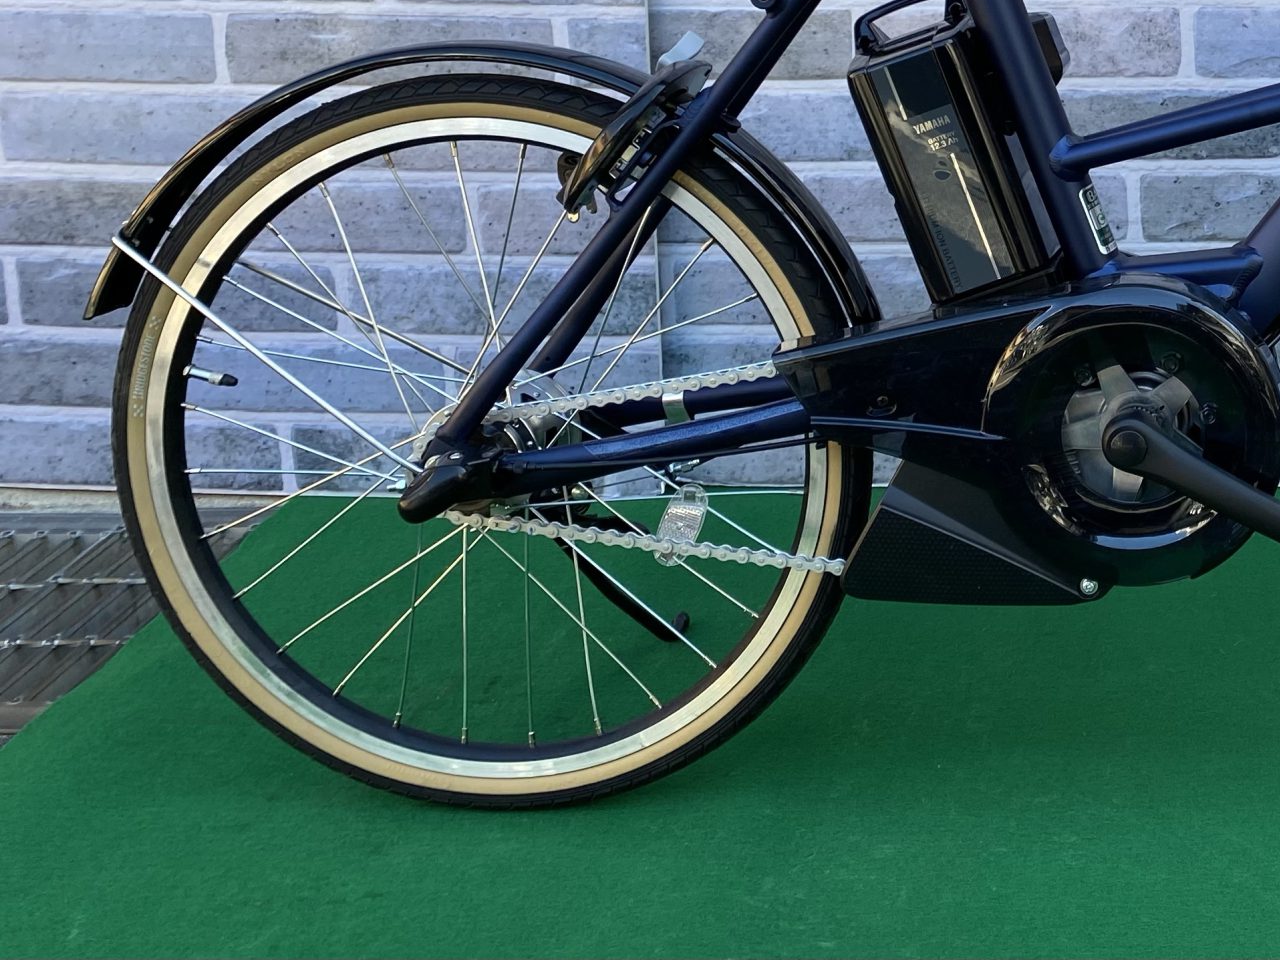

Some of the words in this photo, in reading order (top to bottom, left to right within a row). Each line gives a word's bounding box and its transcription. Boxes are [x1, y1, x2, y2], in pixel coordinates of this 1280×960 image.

[913, 115, 951, 135] YAMAHA
[927, 131, 955, 145] BATTERY
[930, 141, 947, 151] 12.3
[942, 248, 962, 290] BATTERY
[132, 334, 156, 400] BRIDGESTONE
